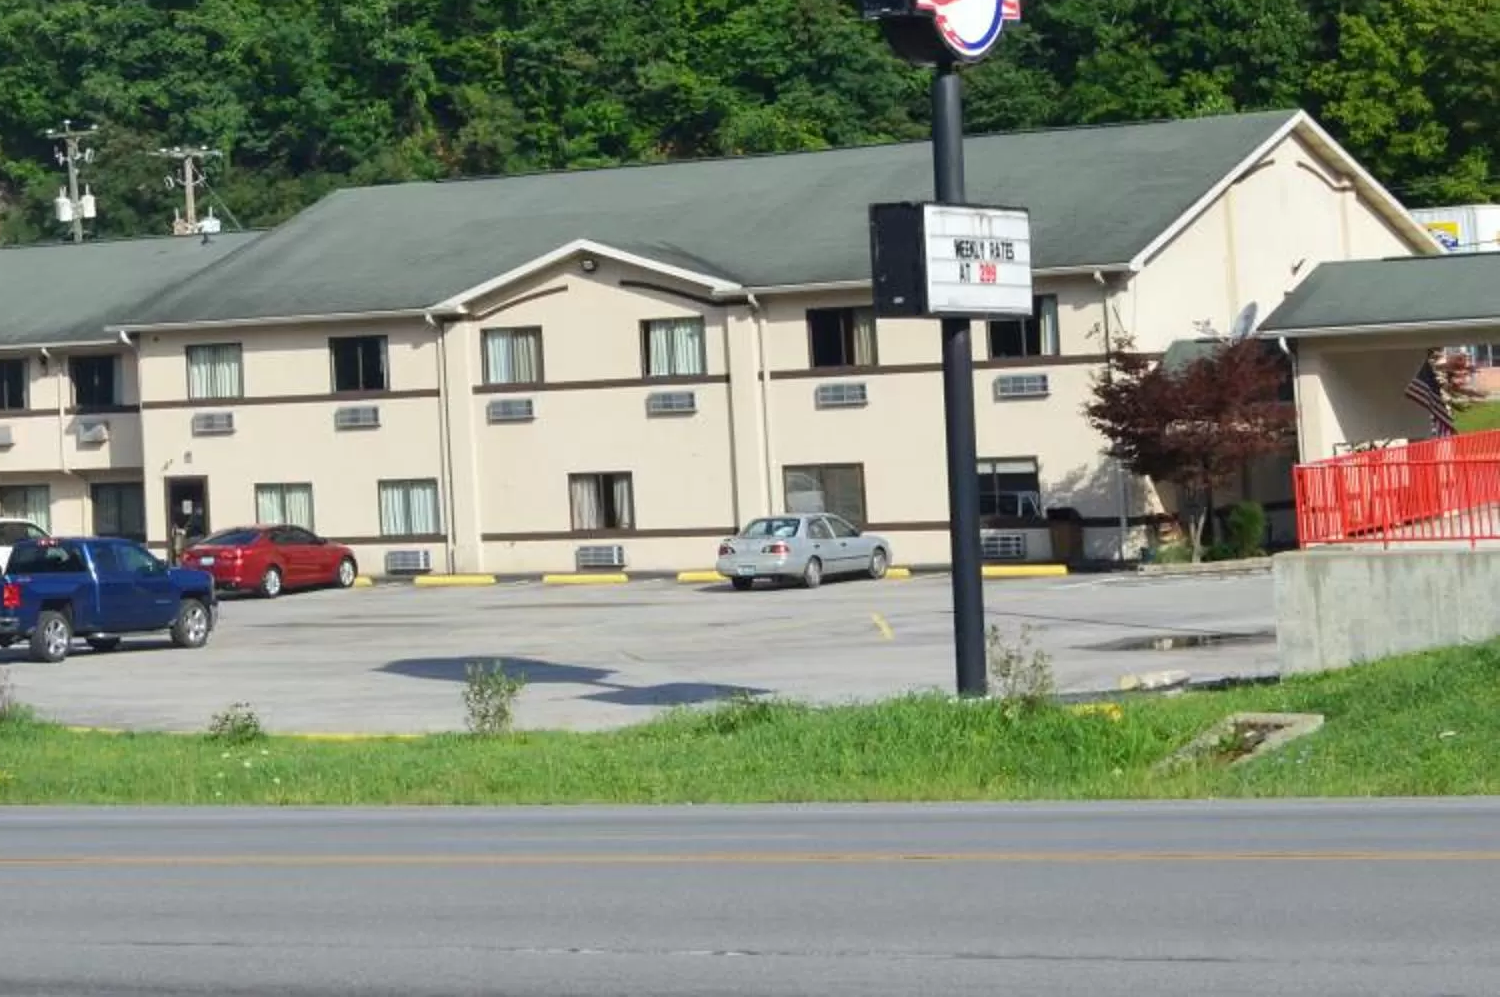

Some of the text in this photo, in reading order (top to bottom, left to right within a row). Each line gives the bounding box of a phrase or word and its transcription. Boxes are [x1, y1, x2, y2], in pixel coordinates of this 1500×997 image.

[954, 238, 1015, 260] WEEKLY RATES
[959, 262, 971, 284] AT
